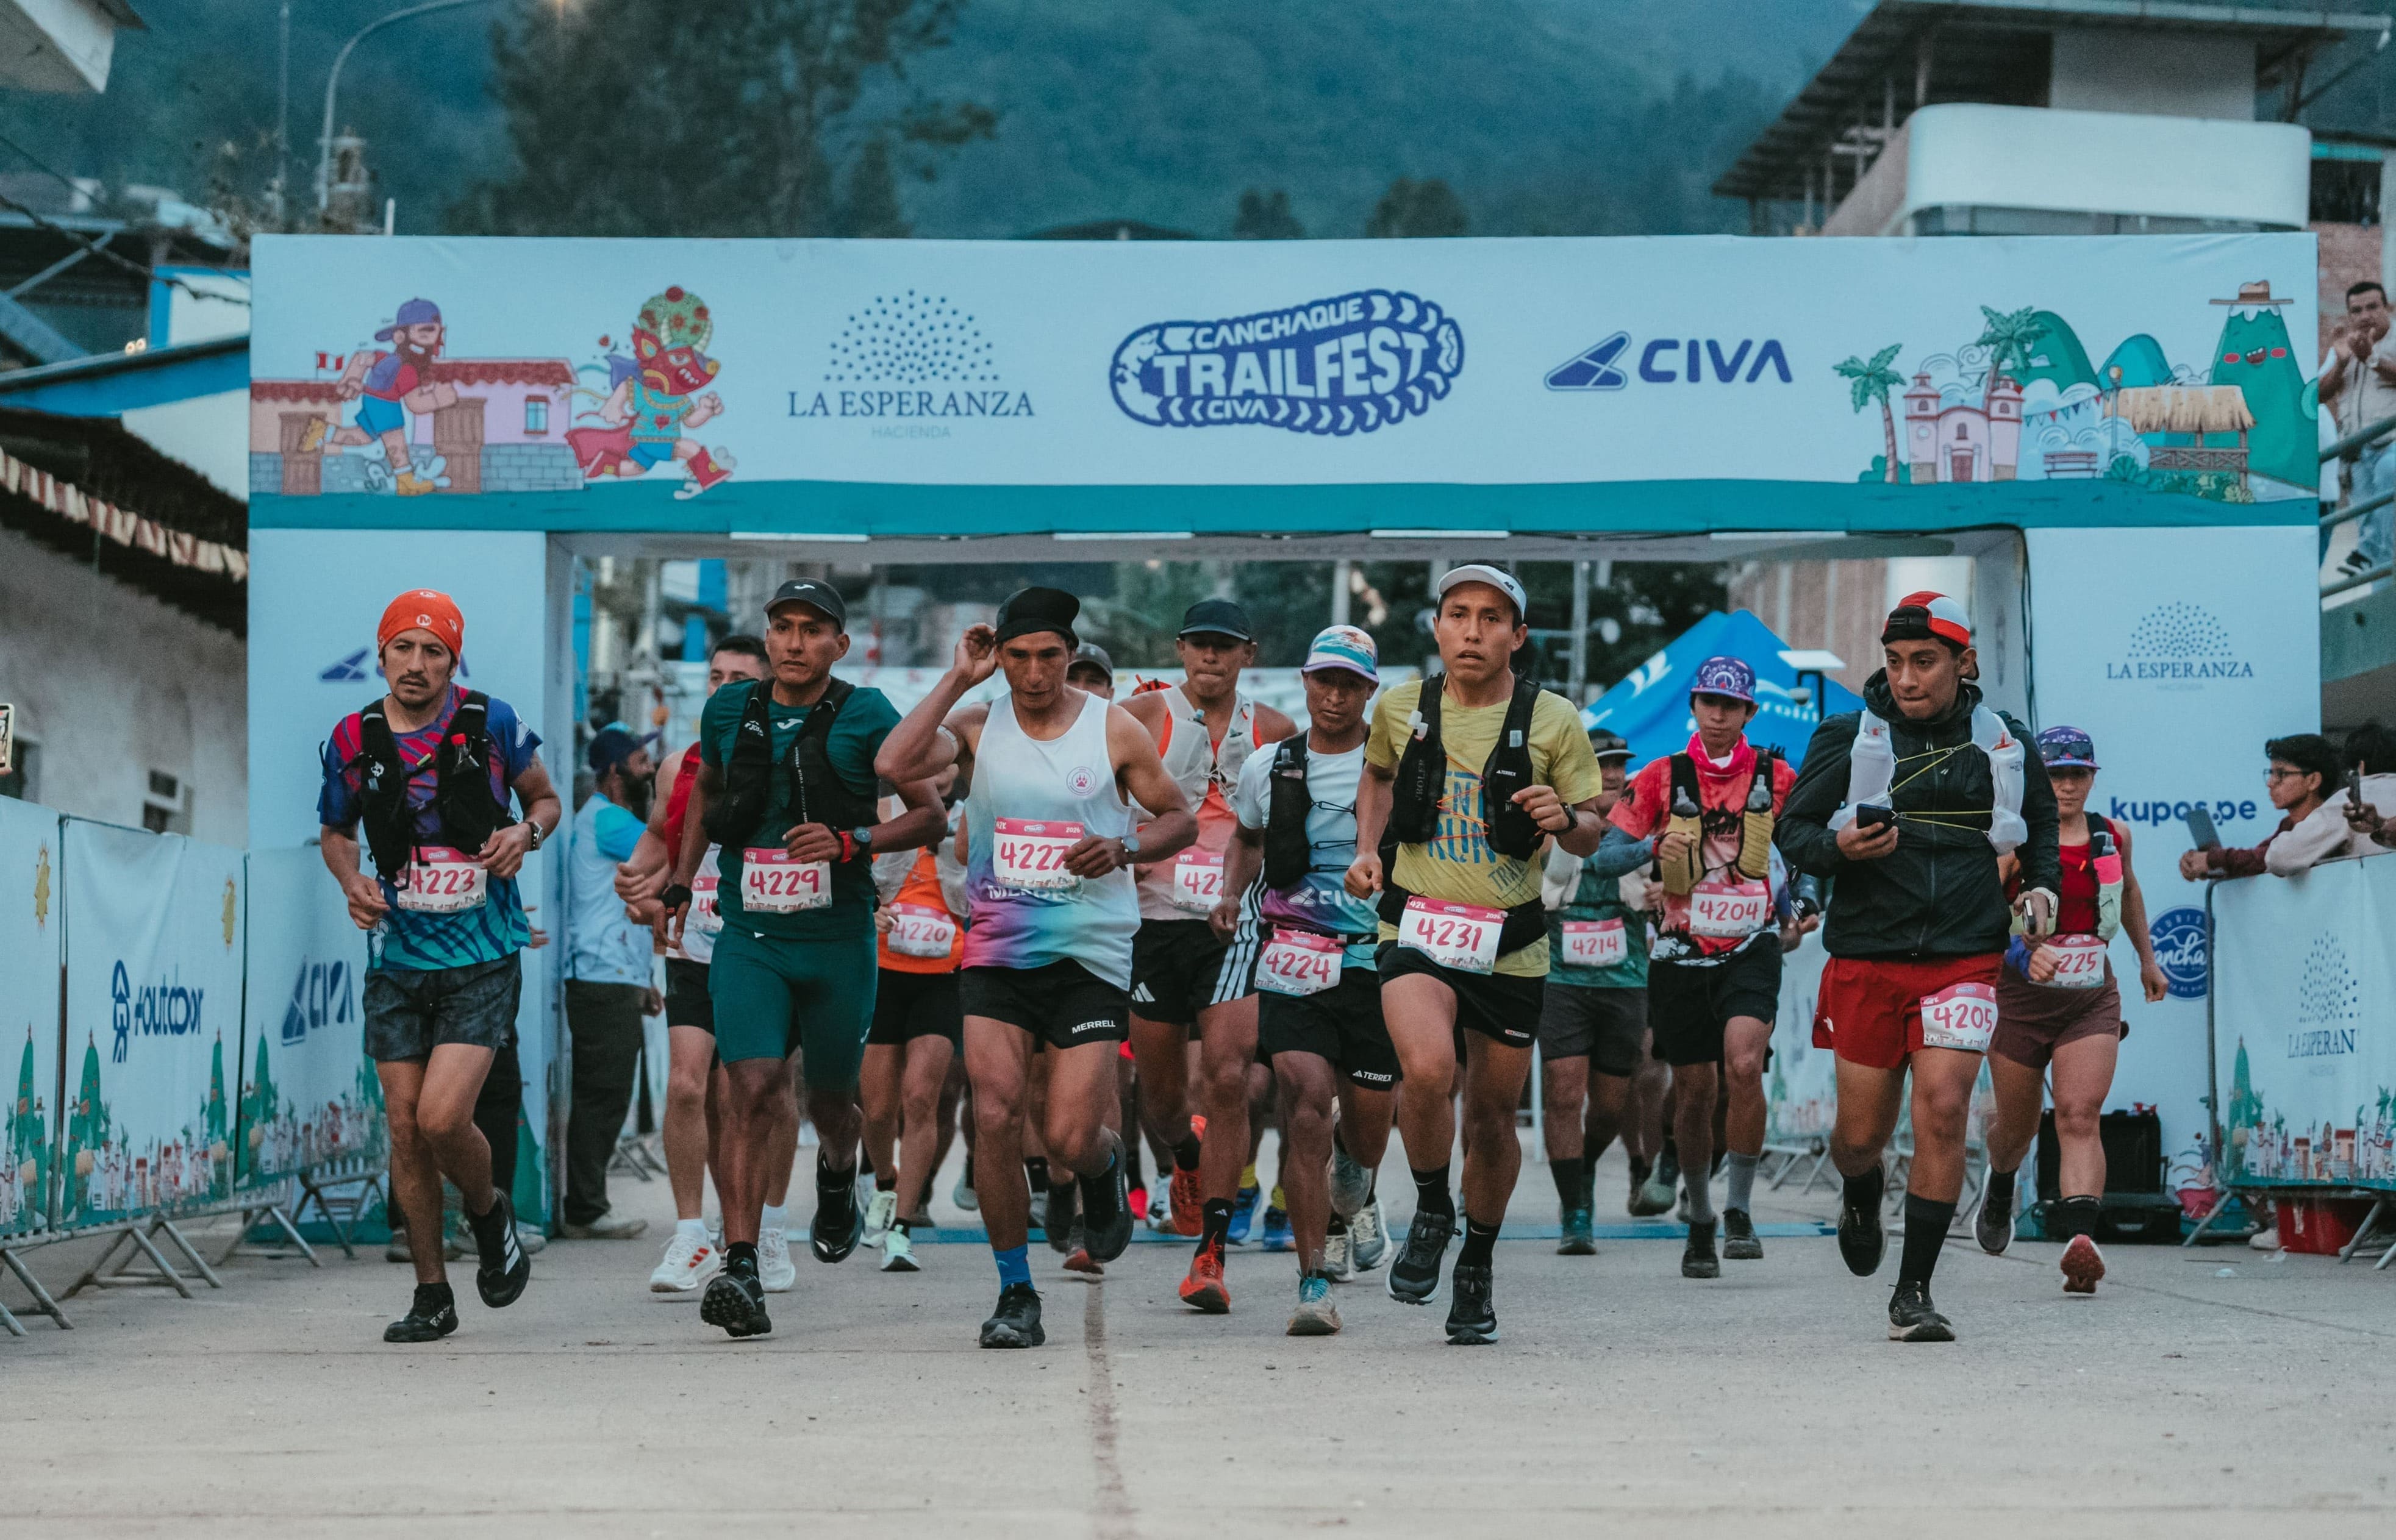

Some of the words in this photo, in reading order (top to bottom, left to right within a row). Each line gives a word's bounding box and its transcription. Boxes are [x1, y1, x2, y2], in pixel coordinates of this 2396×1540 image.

[1195, 298, 1364, 350] CANCHAQUE
[1639, 339, 1793, 383] CIVA
[788, 391, 831, 417] LA
[839, 391, 1035, 417] ESPERANZA
[1207, 397, 1270, 420] CIVA
[871, 426, 951, 439] HACIENDA
[2107, 663, 2133, 679] LA
[2137, 661, 2255, 679] ESPERANZA
[1000, 841, 1070, 871] 4227
[749, 869, 819, 896] 4229
[1409, 900, 1426, 910] 42K
[1699, 900, 1759, 921] 4204
[893, 921, 948, 943] 4220
[1416, 918, 1483, 952] 4231
[1572, 935, 1618, 955] 4214
[1265, 950, 1331, 983] 4224
[2058, 951, 2098, 974] 225
[1071, 1020, 1116, 1034] MERRELL
[1933, 1003, 1993, 1033] 4205
[1364, 1071, 1393, 1082] TERREX
